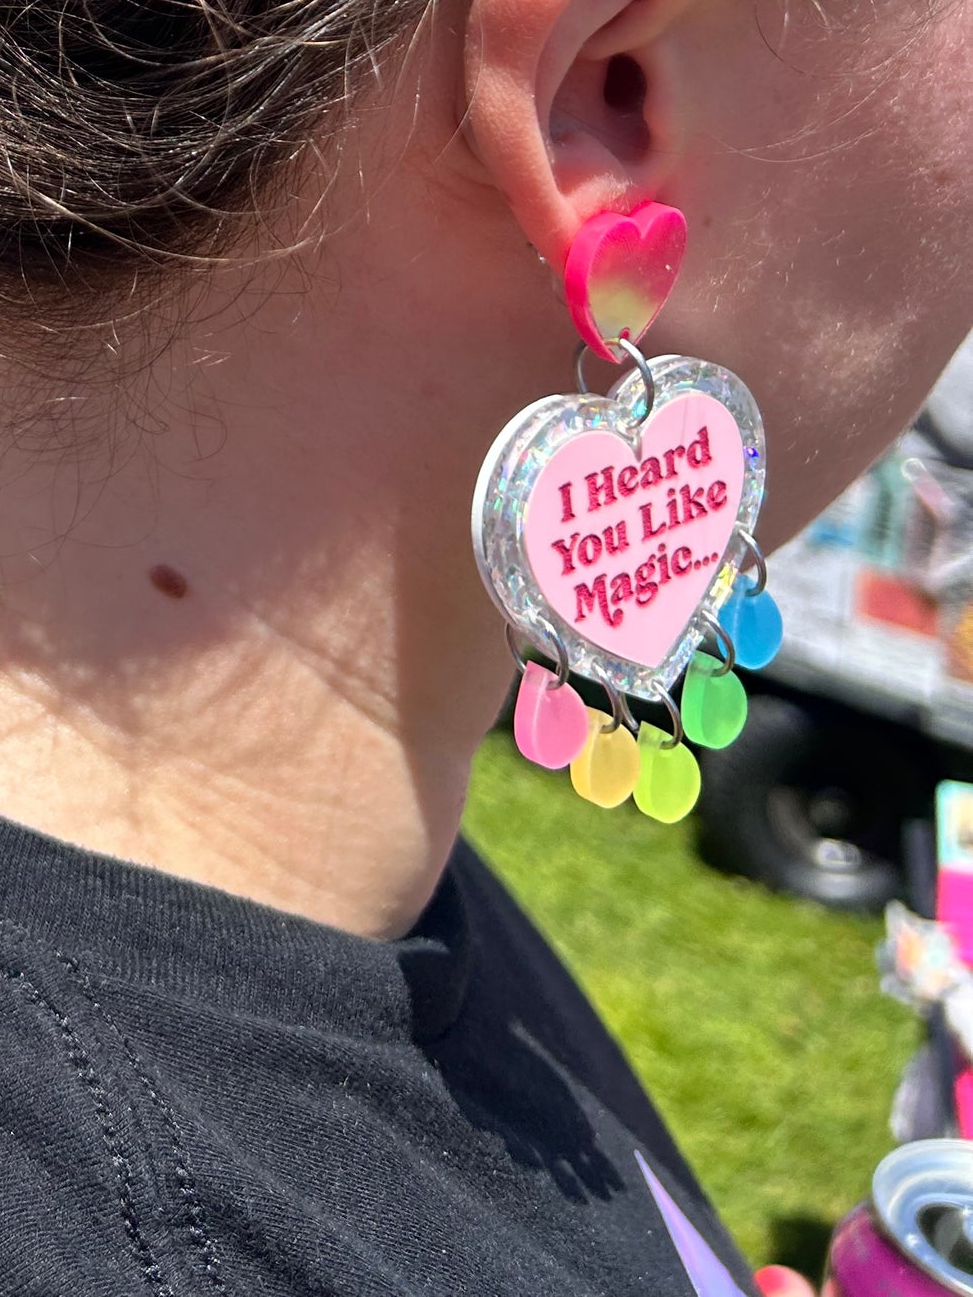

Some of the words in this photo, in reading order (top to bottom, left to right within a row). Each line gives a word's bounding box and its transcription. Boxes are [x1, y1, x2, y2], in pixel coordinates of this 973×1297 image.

[559, 482, 576, 522] I
[584, 426, 712, 512] Heard
[551, 520, 629, 575] You
[639, 479, 727, 540] Like
[574, 543, 718, 628] Magic...
